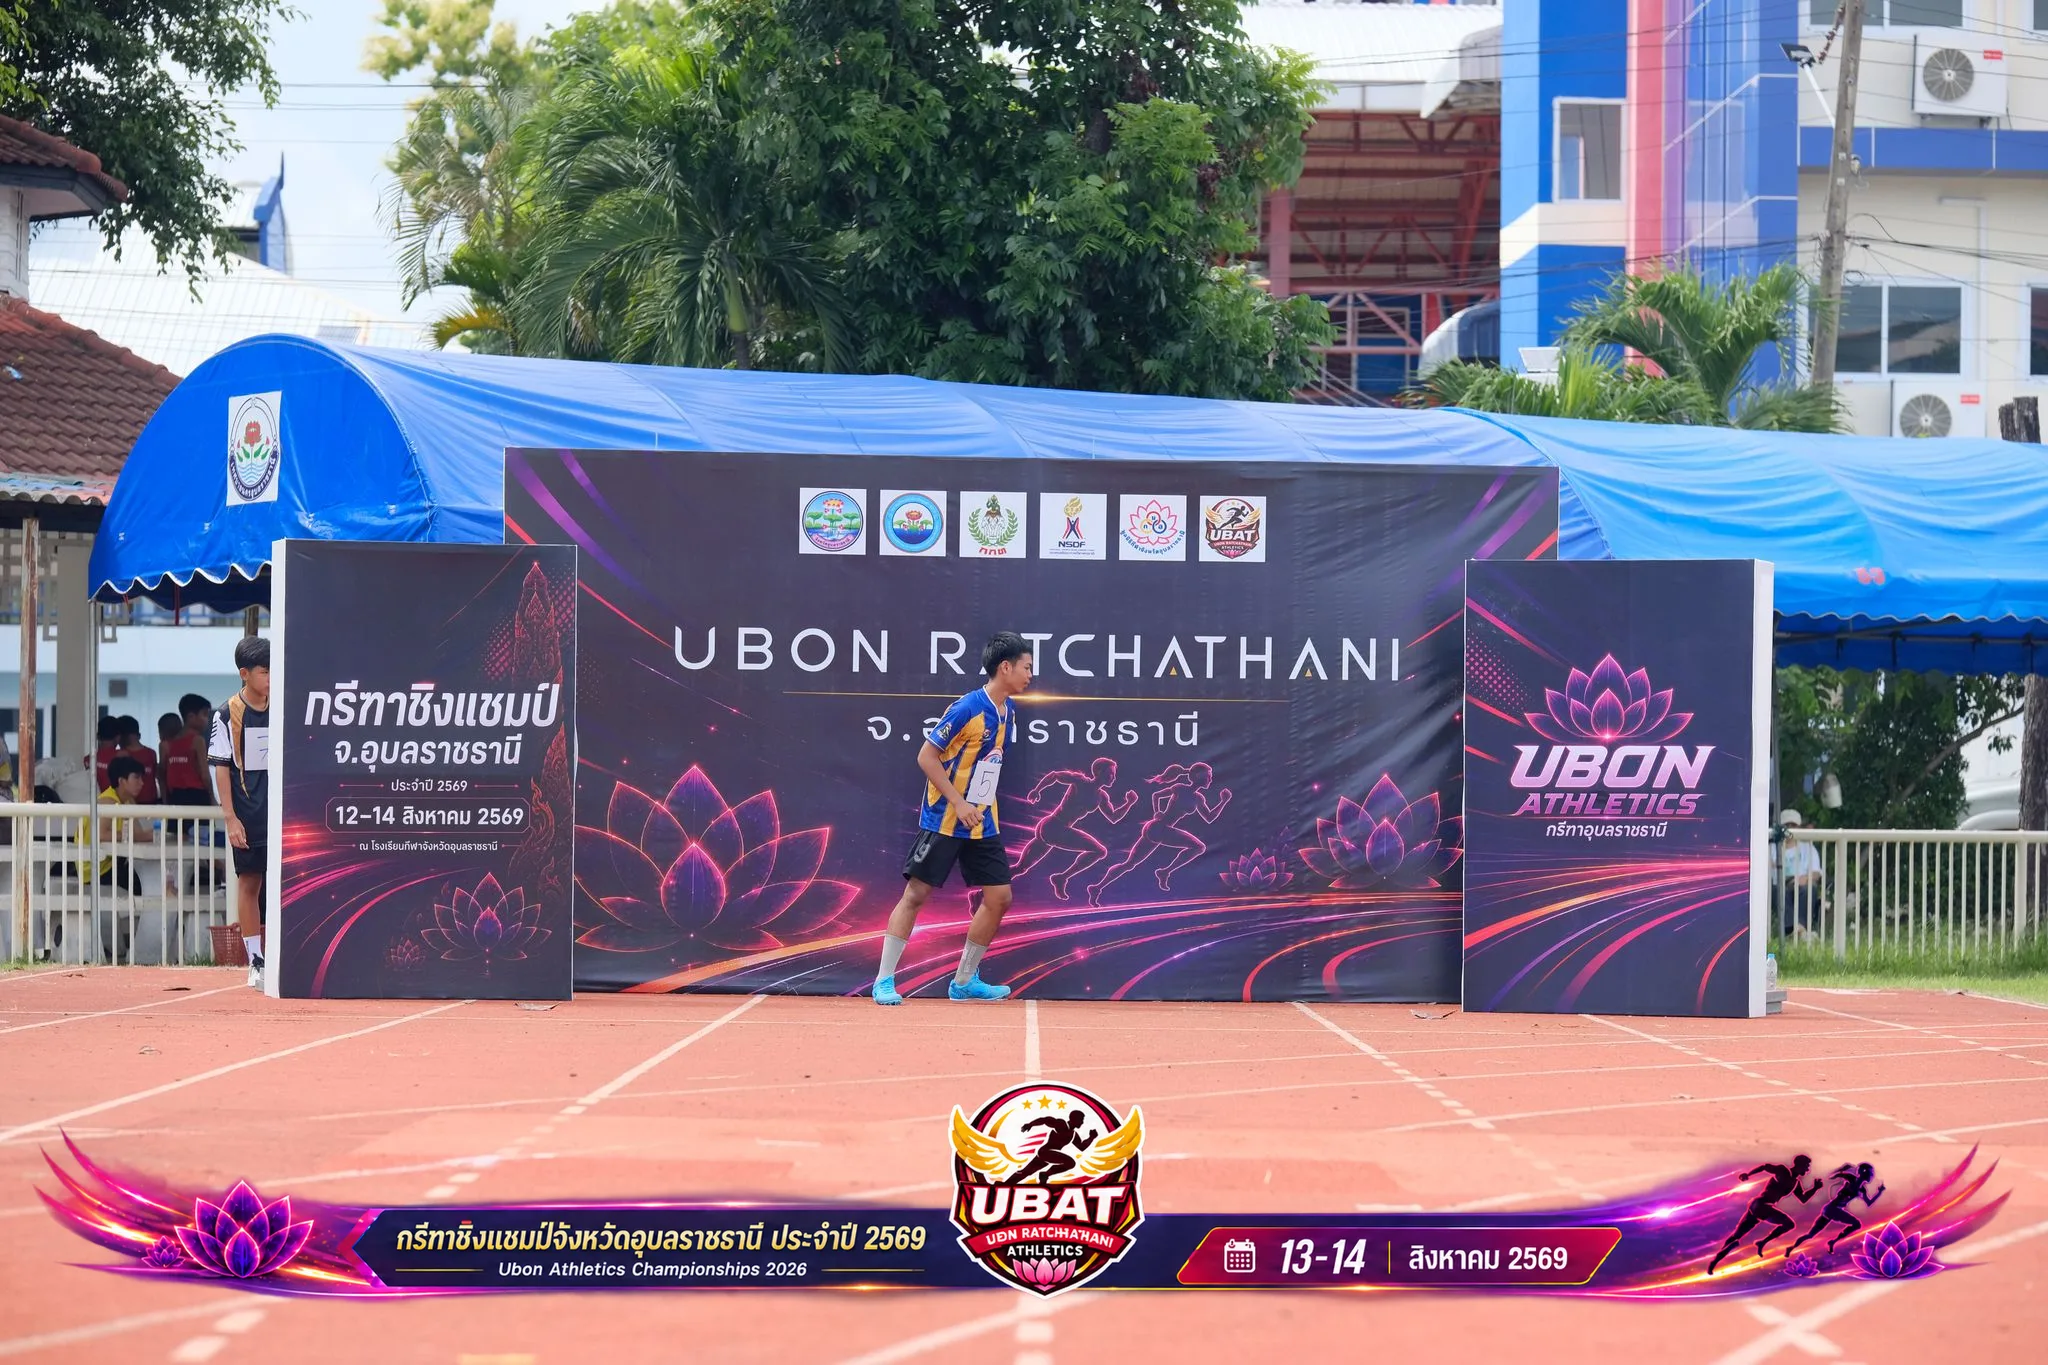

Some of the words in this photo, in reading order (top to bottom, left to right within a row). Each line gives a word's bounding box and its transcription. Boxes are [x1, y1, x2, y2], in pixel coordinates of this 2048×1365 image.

[1210, 530, 1256, 541] UBAT
[674, 626, 887, 675] UBON
[931, 631, 1401, 682] RTCHATHANI
[304, 680, 560, 727] กรีฑาชิงแชมป์
[1511, 746, 1715, 788] UBON
[391, 778, 434, 792] ประจำปี
[437, 780, 468, 792] 2569
[977, 770, 994, 798] 5
[402, 805, 471, 825] สิงหาคม
[477, 808, 524, 825] 2569
[1513, 793, 1703, 816] ATHLETICS
[1546, 820, 1668, 841] กรีฑาอุบลราชธานี
[359, 842, 369, 851] ณ
